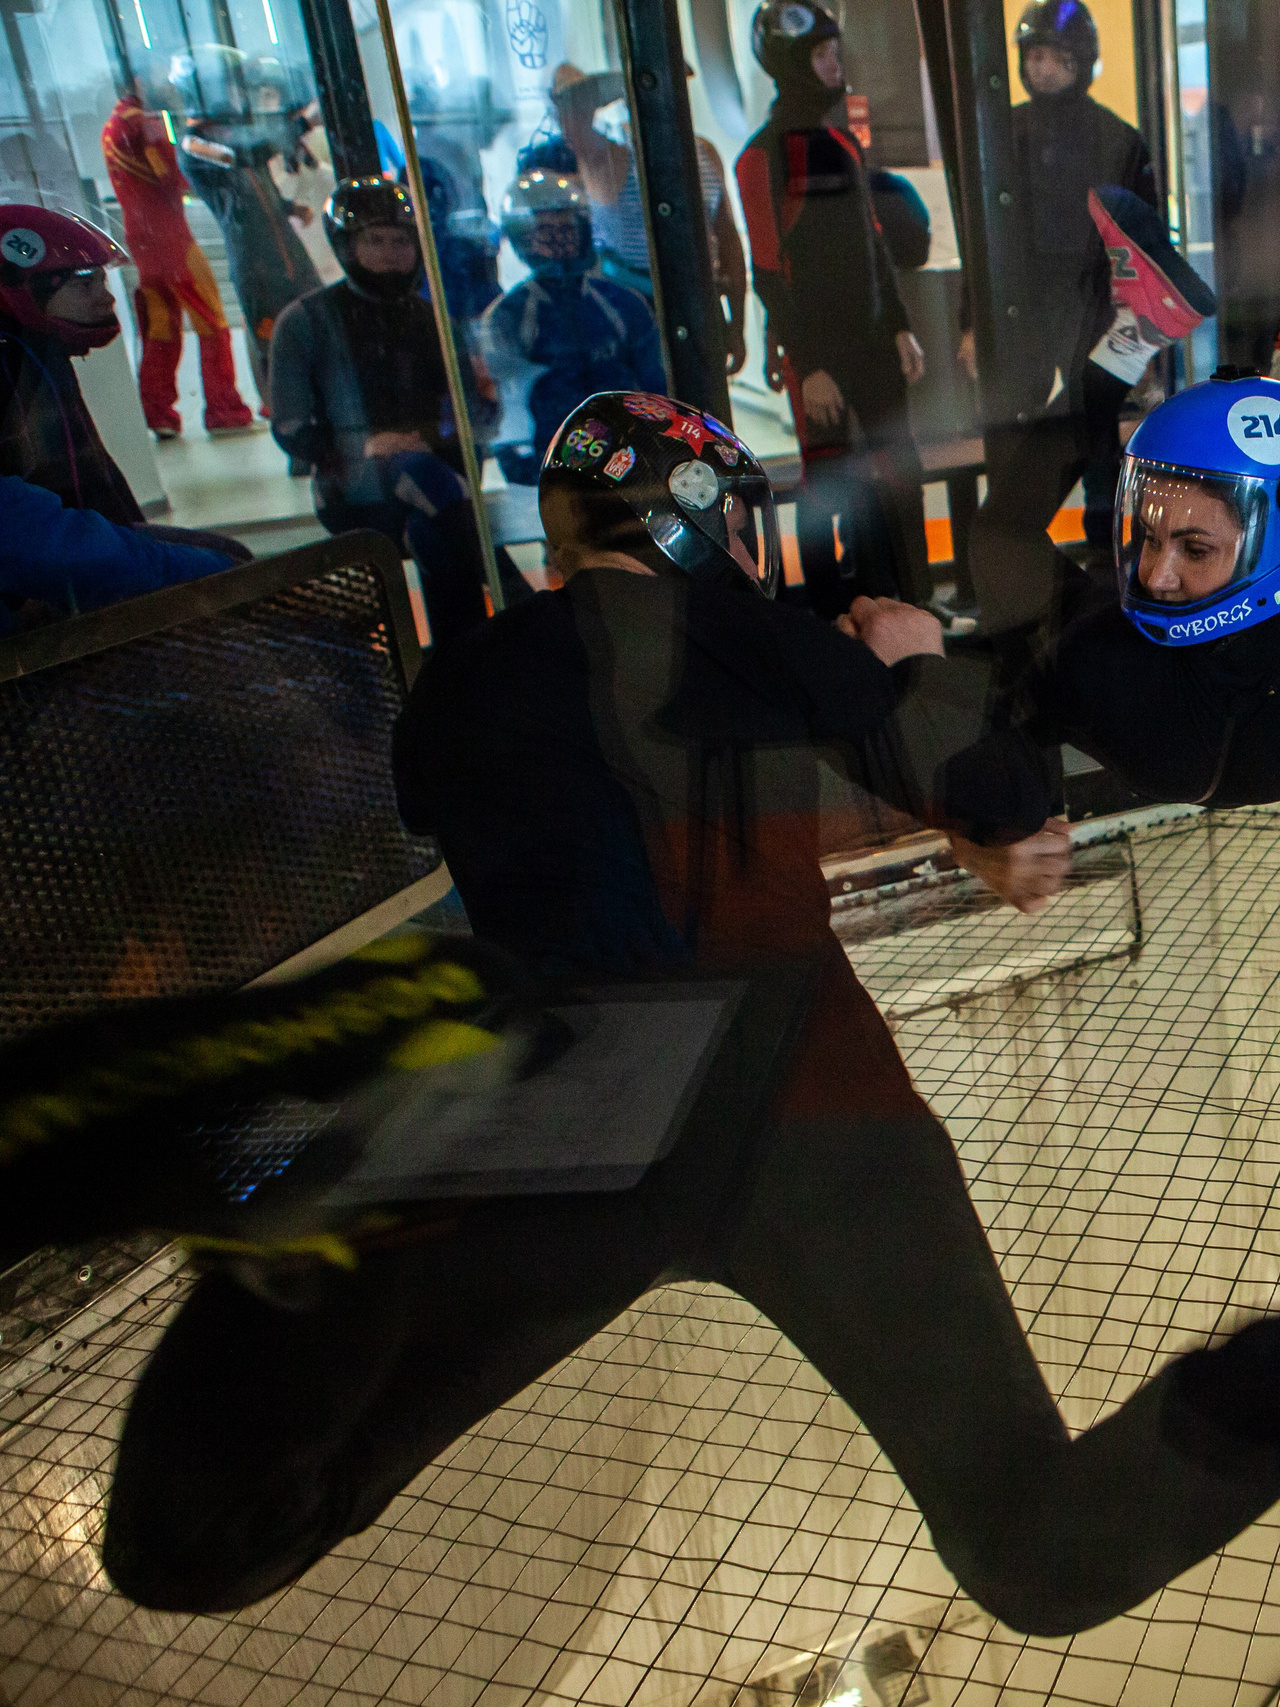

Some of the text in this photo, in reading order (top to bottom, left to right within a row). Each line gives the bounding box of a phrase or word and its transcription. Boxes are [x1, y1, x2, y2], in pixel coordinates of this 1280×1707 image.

[6, 234, 38, 260] 201
[680, 420, 701, 440] 114
[1168, 598, 1253, 639] CYBORGS
